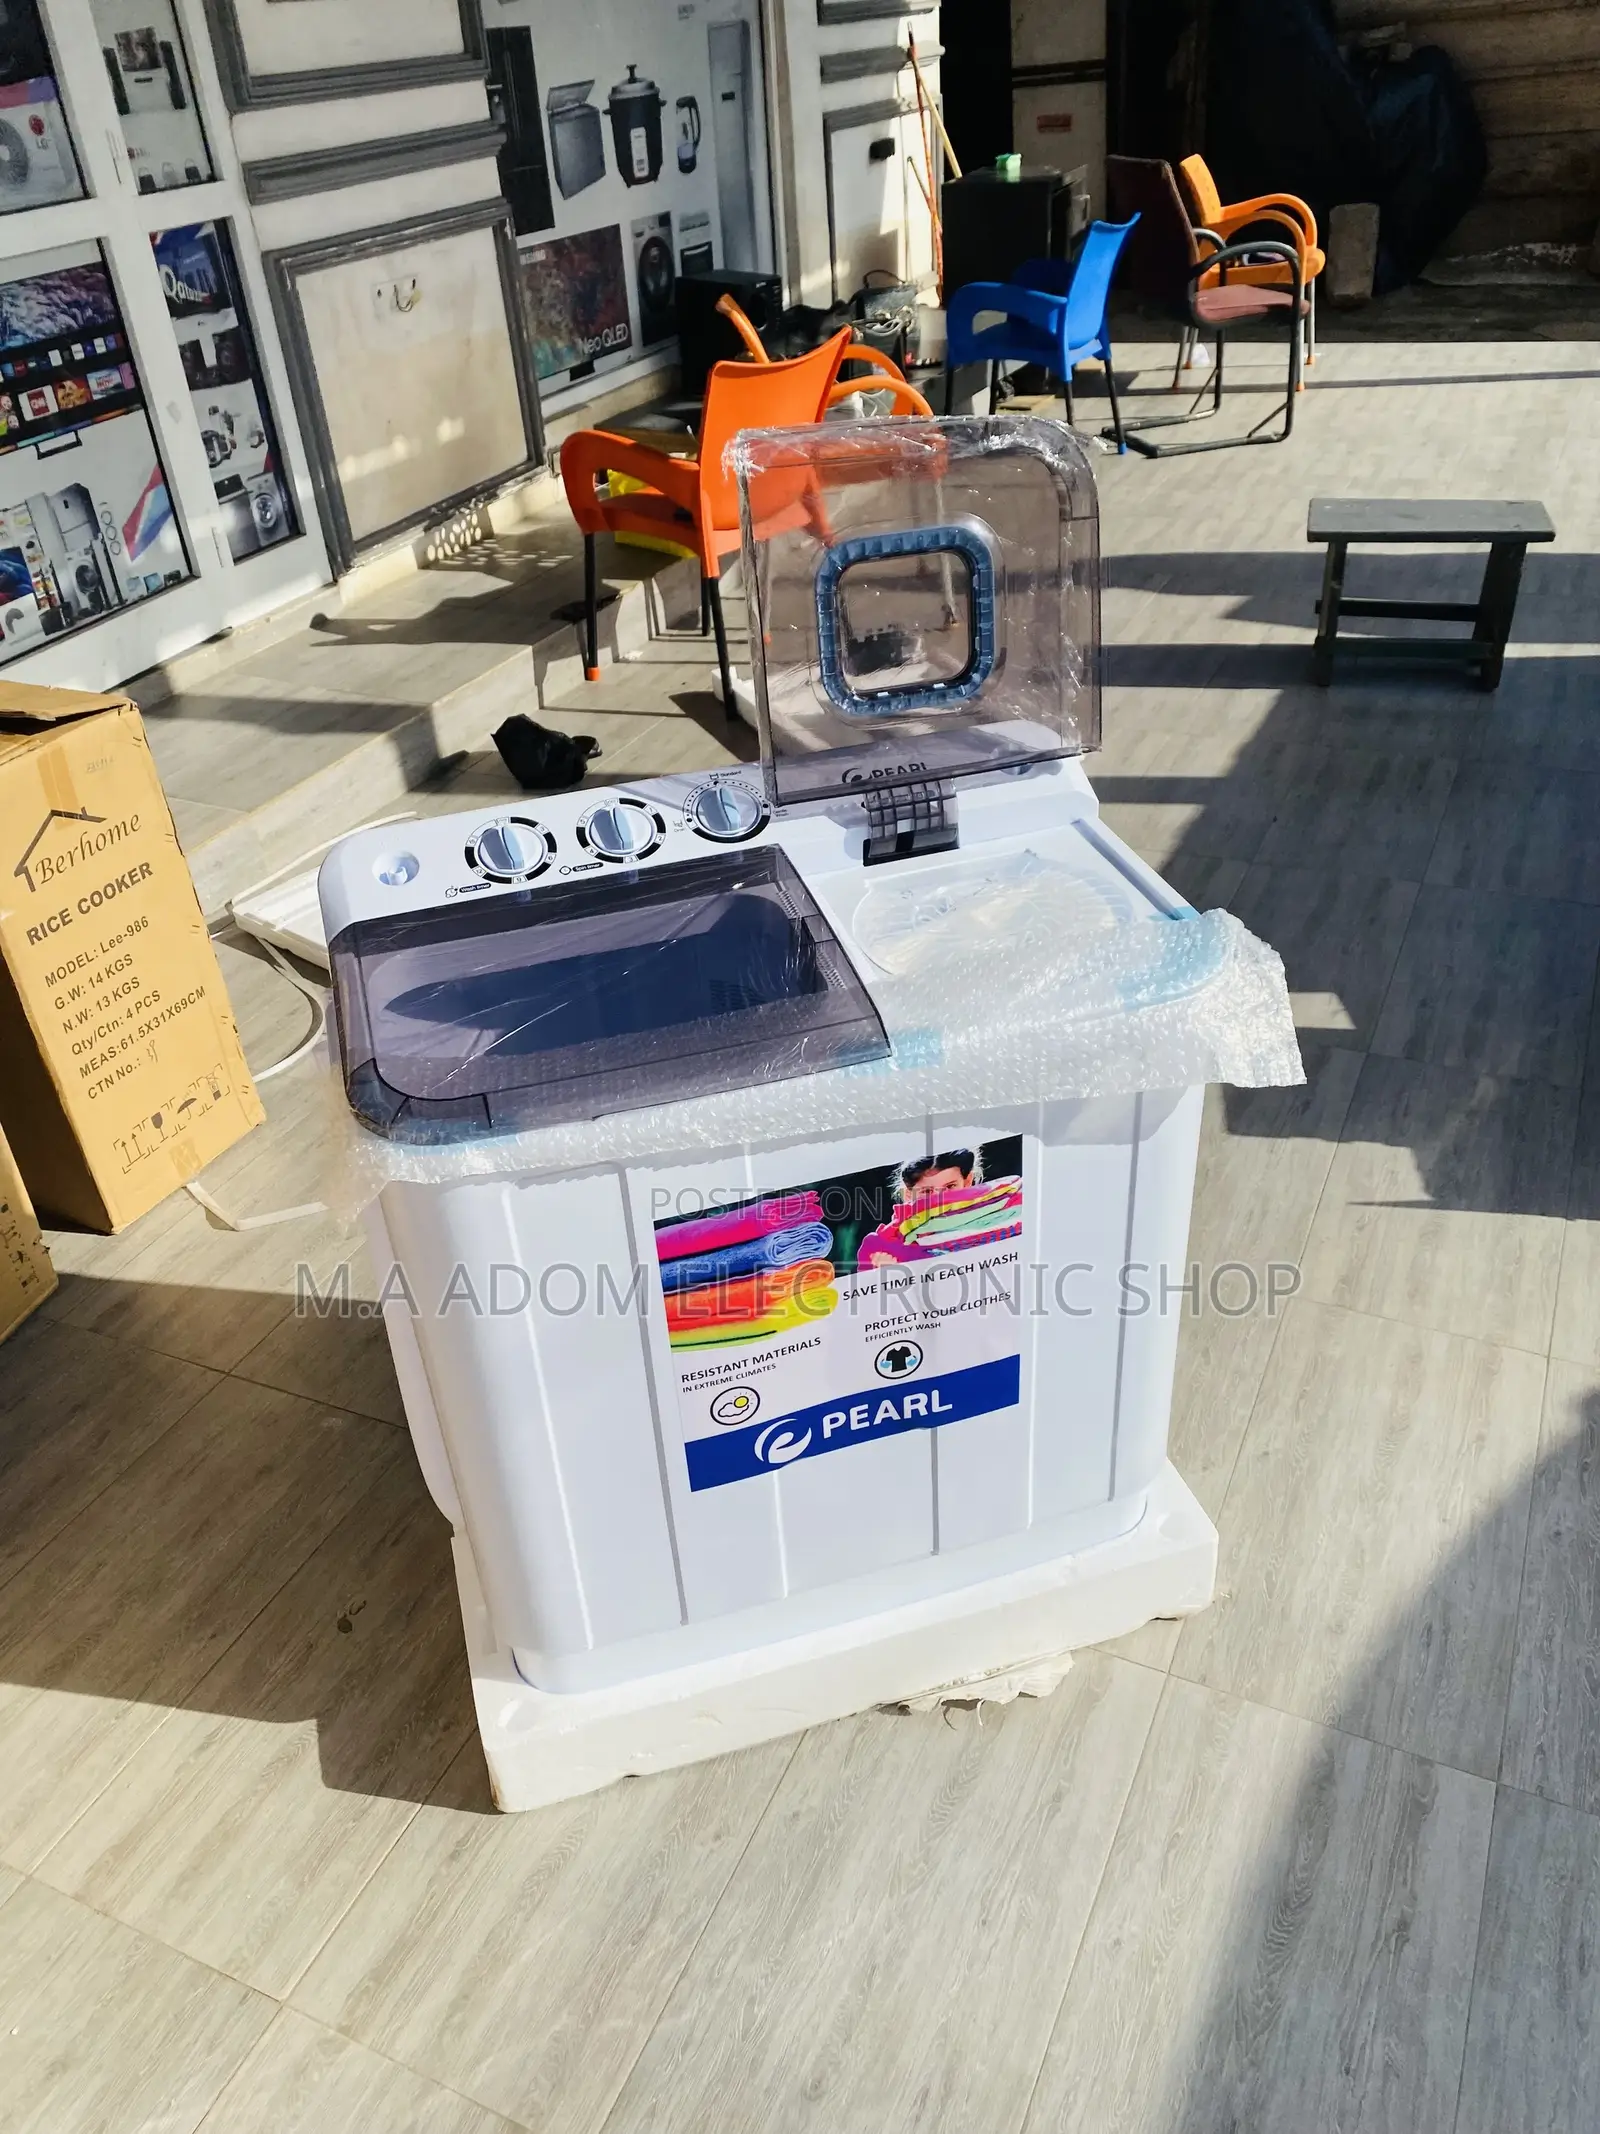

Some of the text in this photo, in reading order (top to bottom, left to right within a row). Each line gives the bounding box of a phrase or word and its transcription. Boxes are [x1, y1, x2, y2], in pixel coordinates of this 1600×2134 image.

[35, 814, 142, 884] Berhome
[26, 862, 154, 946] RICE COOKER
[44, 916, 149, 988] MODEL: Lee-986
[54, 953, 134, 1010] G.W: 14 KGS
[62, 976, 140, 1034] N.W: 13 KGS
[71, 990, 161, 1056] Qty/Ctn: 4 PCS
[88, 1075, 115, 1100] CTN
[842, 1251, 1018, 1301] SAVE TIME IN EACH WASH
[864, 1291, 1011, 1332] PROTECT YOUR CLOTHES
[865, 1321, 941, 1343] EFFICIENTLY WASH
[681, 1336, 821, 1383] RESISTANT MATERIALS
[682, 1363, 777, 1394] IN EXTREME CLIMATES
[822, 1389, 953, 1440] PEARL
